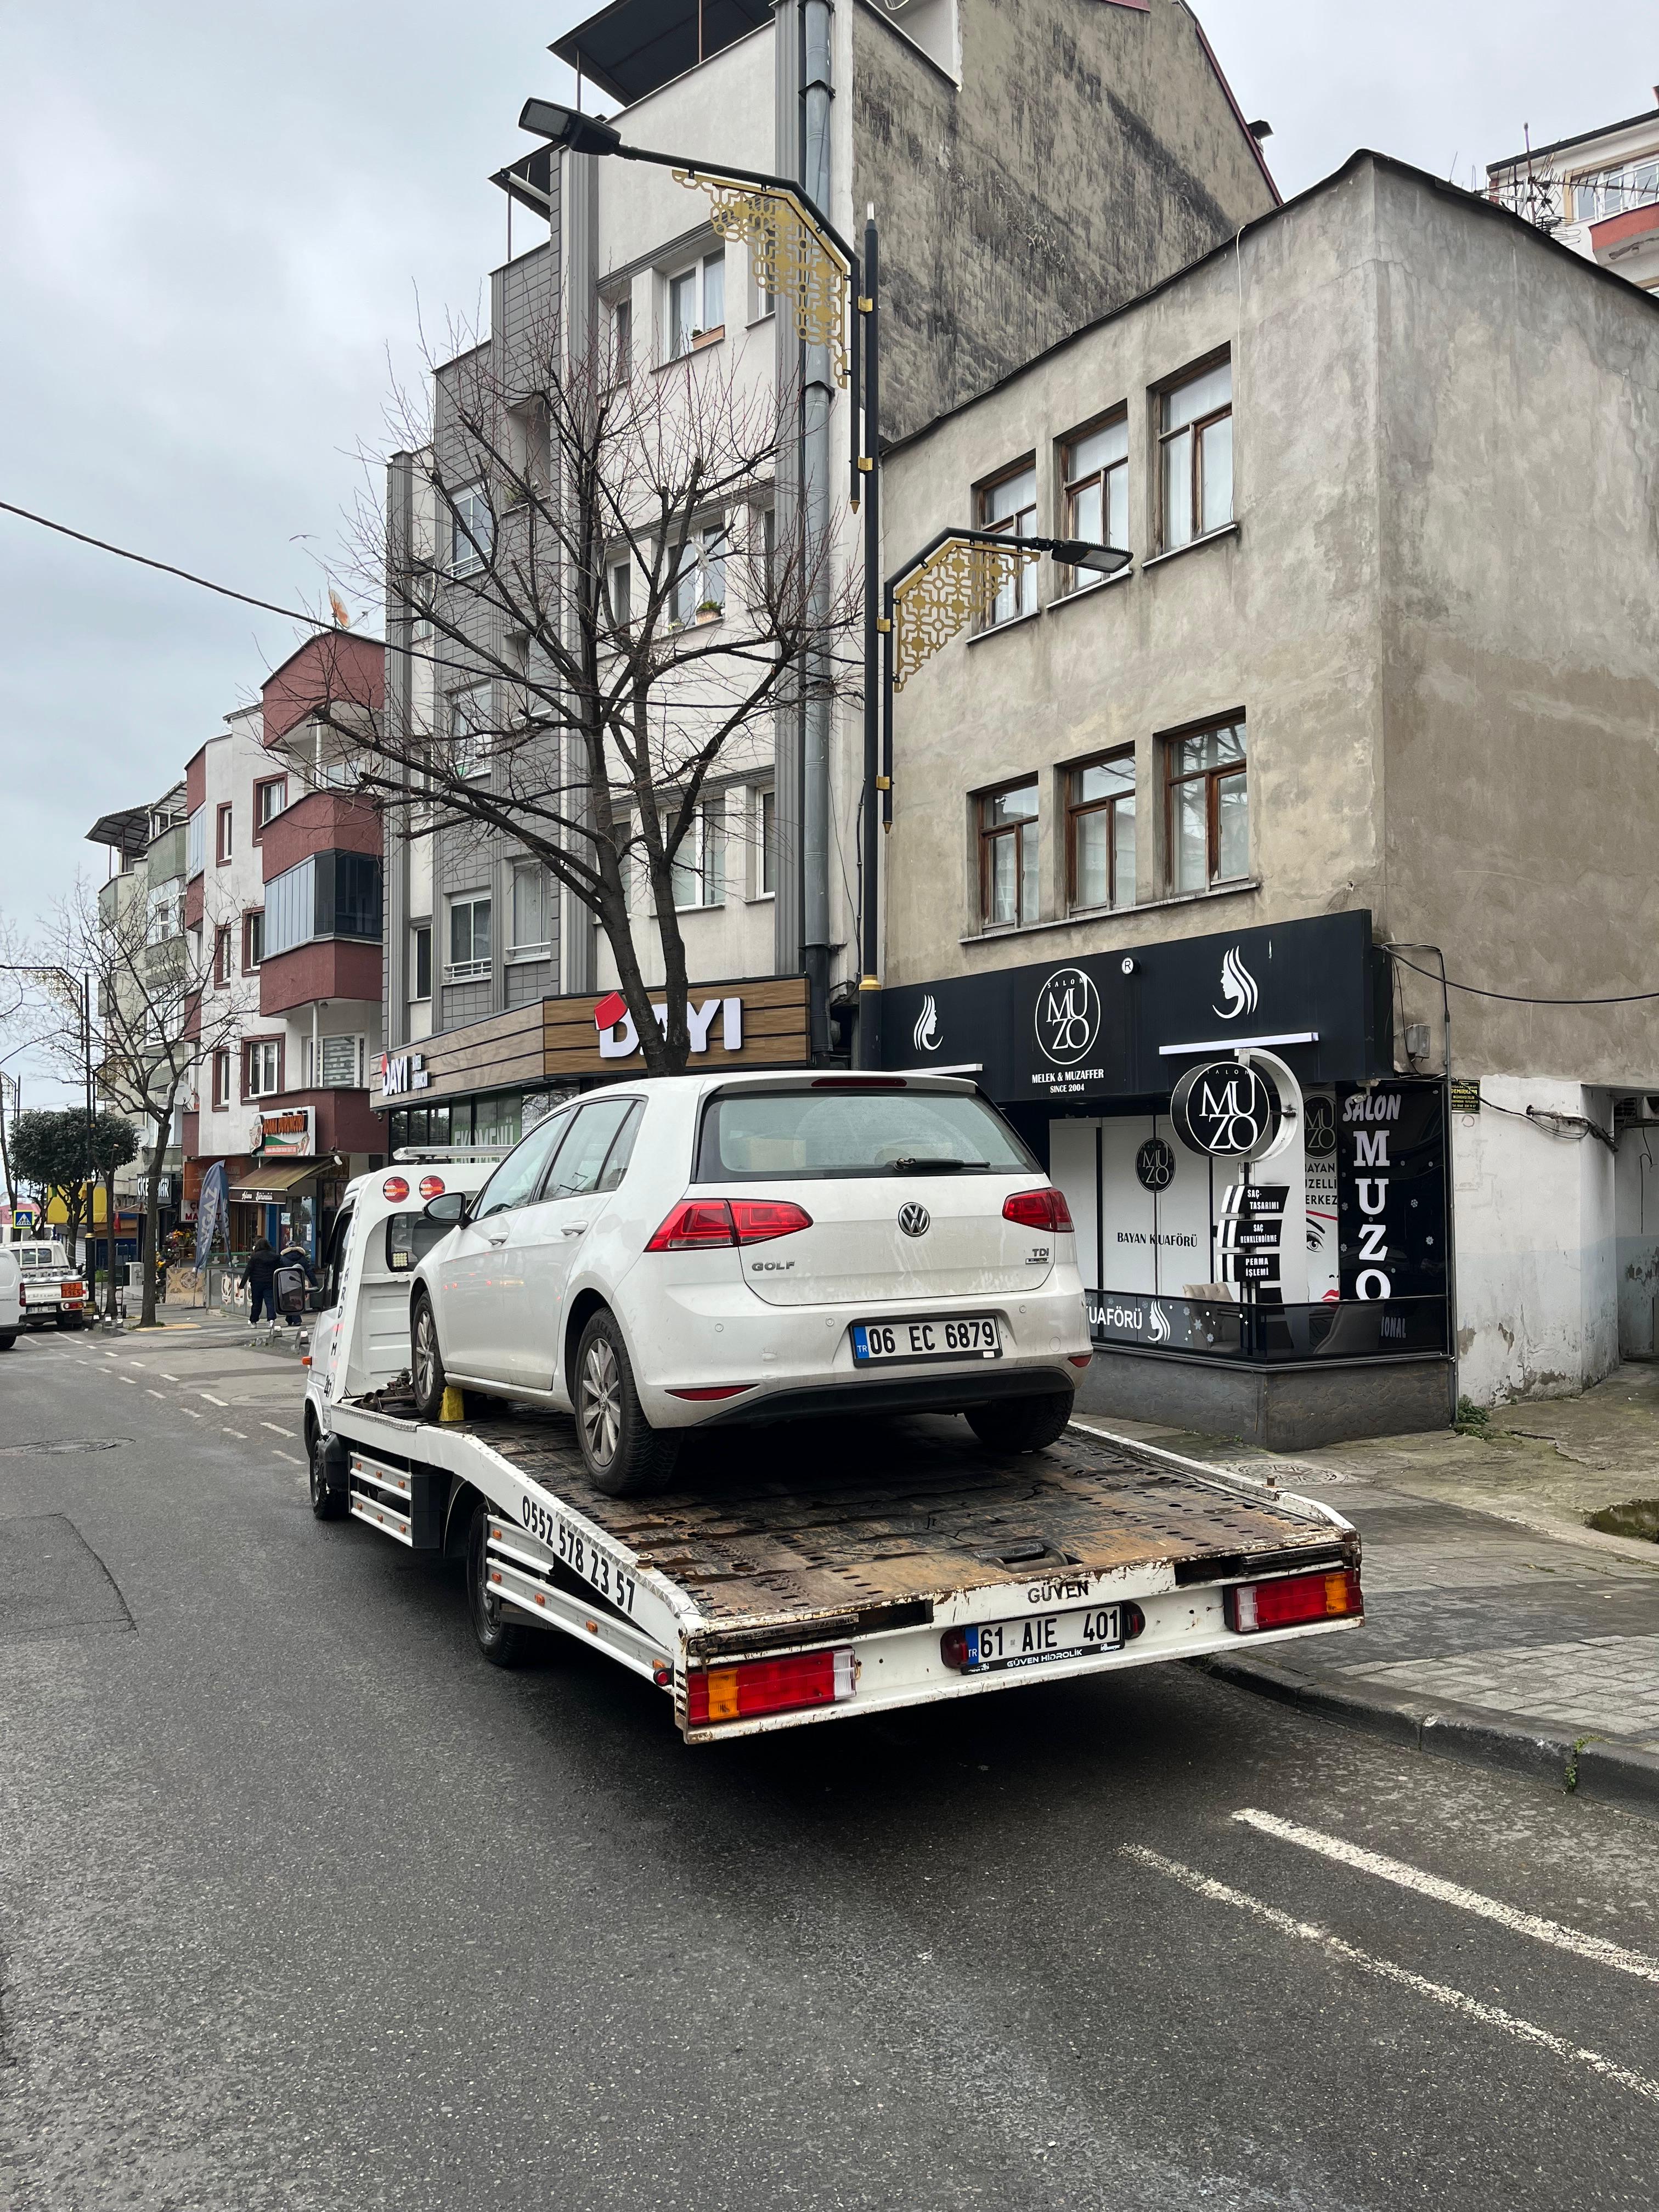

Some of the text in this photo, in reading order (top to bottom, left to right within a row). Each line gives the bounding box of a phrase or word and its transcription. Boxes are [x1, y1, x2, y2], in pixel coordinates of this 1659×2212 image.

[382, 1056, 408, 1096] DAYI
[1032, 1069, 1104, 1084] MELEK & MUZAFFER
[1050, 1084, 1085, 1093] SINCE 2004
[1342, 1094, 1401, 1121] SALON
[1250, 1201, 1279, 1210] TASARIMI
[1253, 1224, 1263, 1233] SAÇ
[1117, 1232, 1147, 1244] BAYAN
[1032, 1248, 1049, 1257] TDI
[752, 1261, 795, 1272] GOLF
[1245, 1257, 1269, 1266] PERMA
[1245, 1267, 1269, 1277] İŞLEMİ
[1086, 1305, 1143, 1330] UAFÖRÜ
[868, 1328, 896, 1355] 06
[909, 1325, 935, 1352] EC
[945, 1321, 995, 1349] 6879
[522, 1495, 635, 1614] 0552 578 23 57
[1028, 1579, 1090, 1604] GÜVEN
[980, 1626, 1003, 1658] 61
[1022, 1617, 1058, 1653] AIE
[1083, 1609, 1119, 1641] 401
[1007, 1648, 1083, 1668] GÜVEN HİDROLİK
